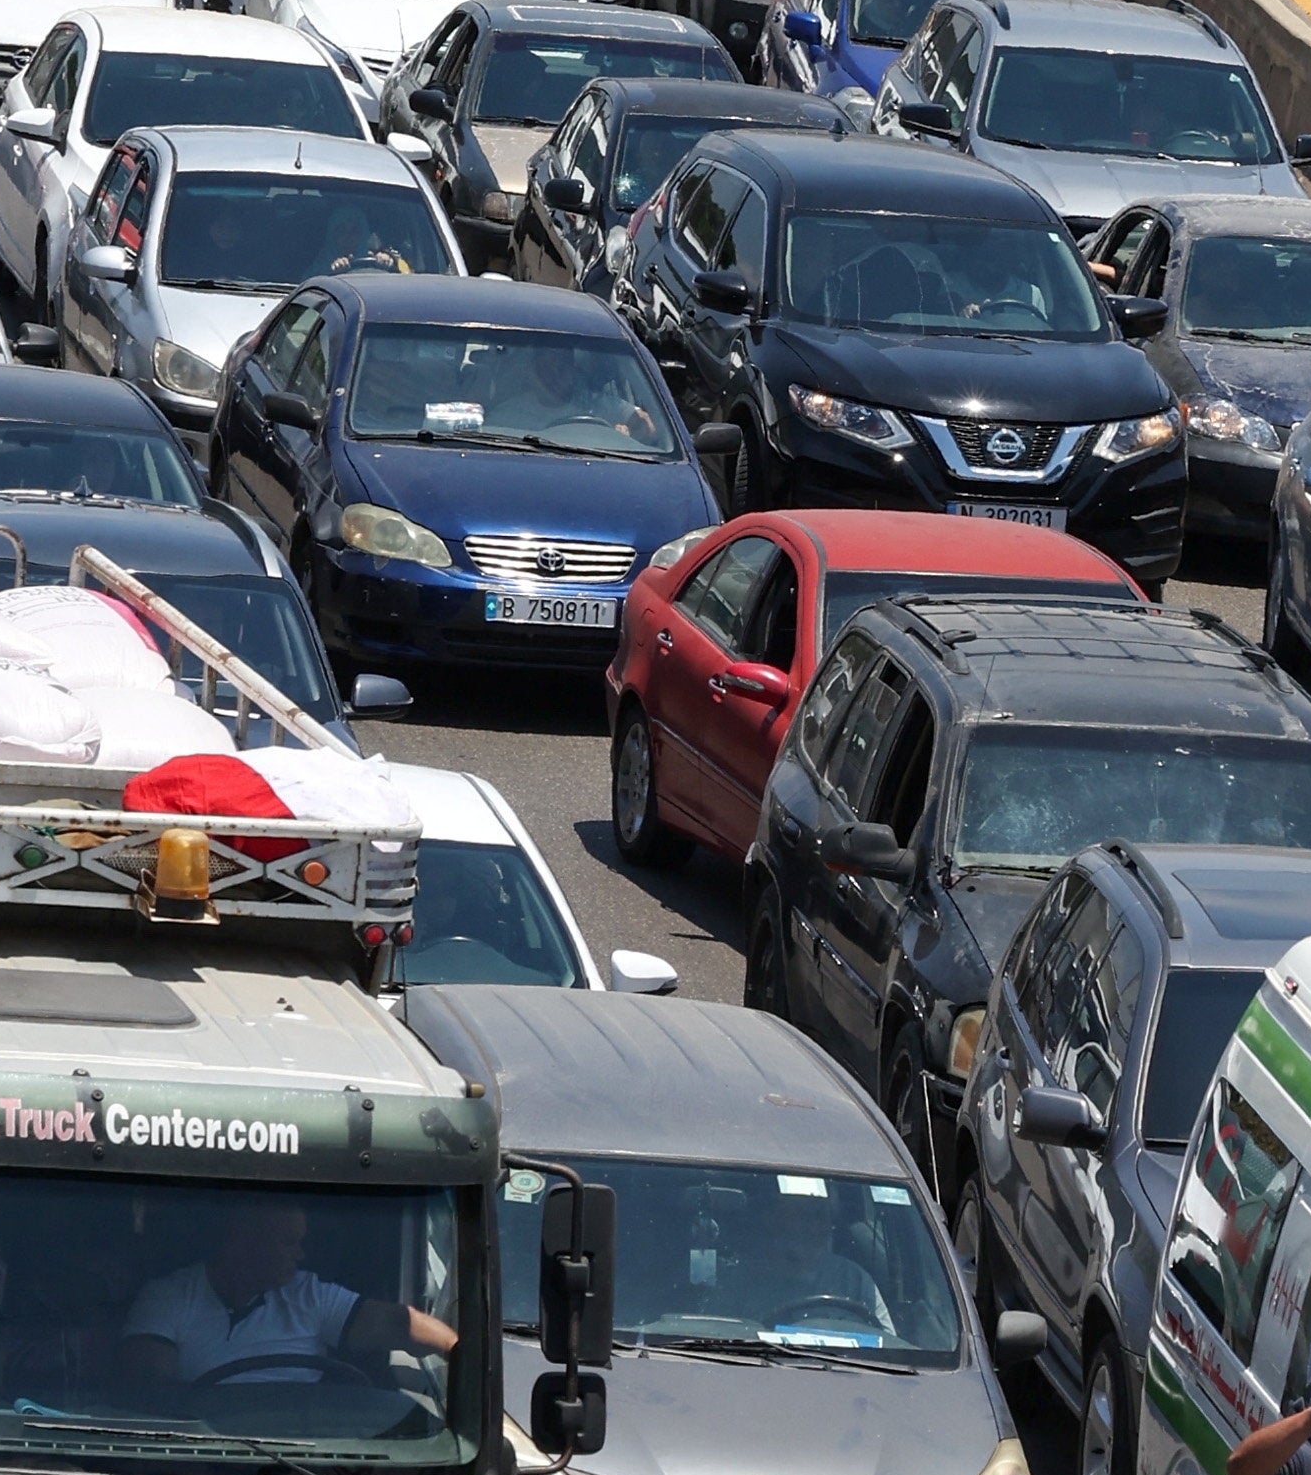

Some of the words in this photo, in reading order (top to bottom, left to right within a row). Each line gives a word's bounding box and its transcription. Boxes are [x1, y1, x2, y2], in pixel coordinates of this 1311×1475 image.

[503, 598, 515, 618] B
[528, 599, 601, 624] 750811
[106, 1103, 300, 1156] Center.com
